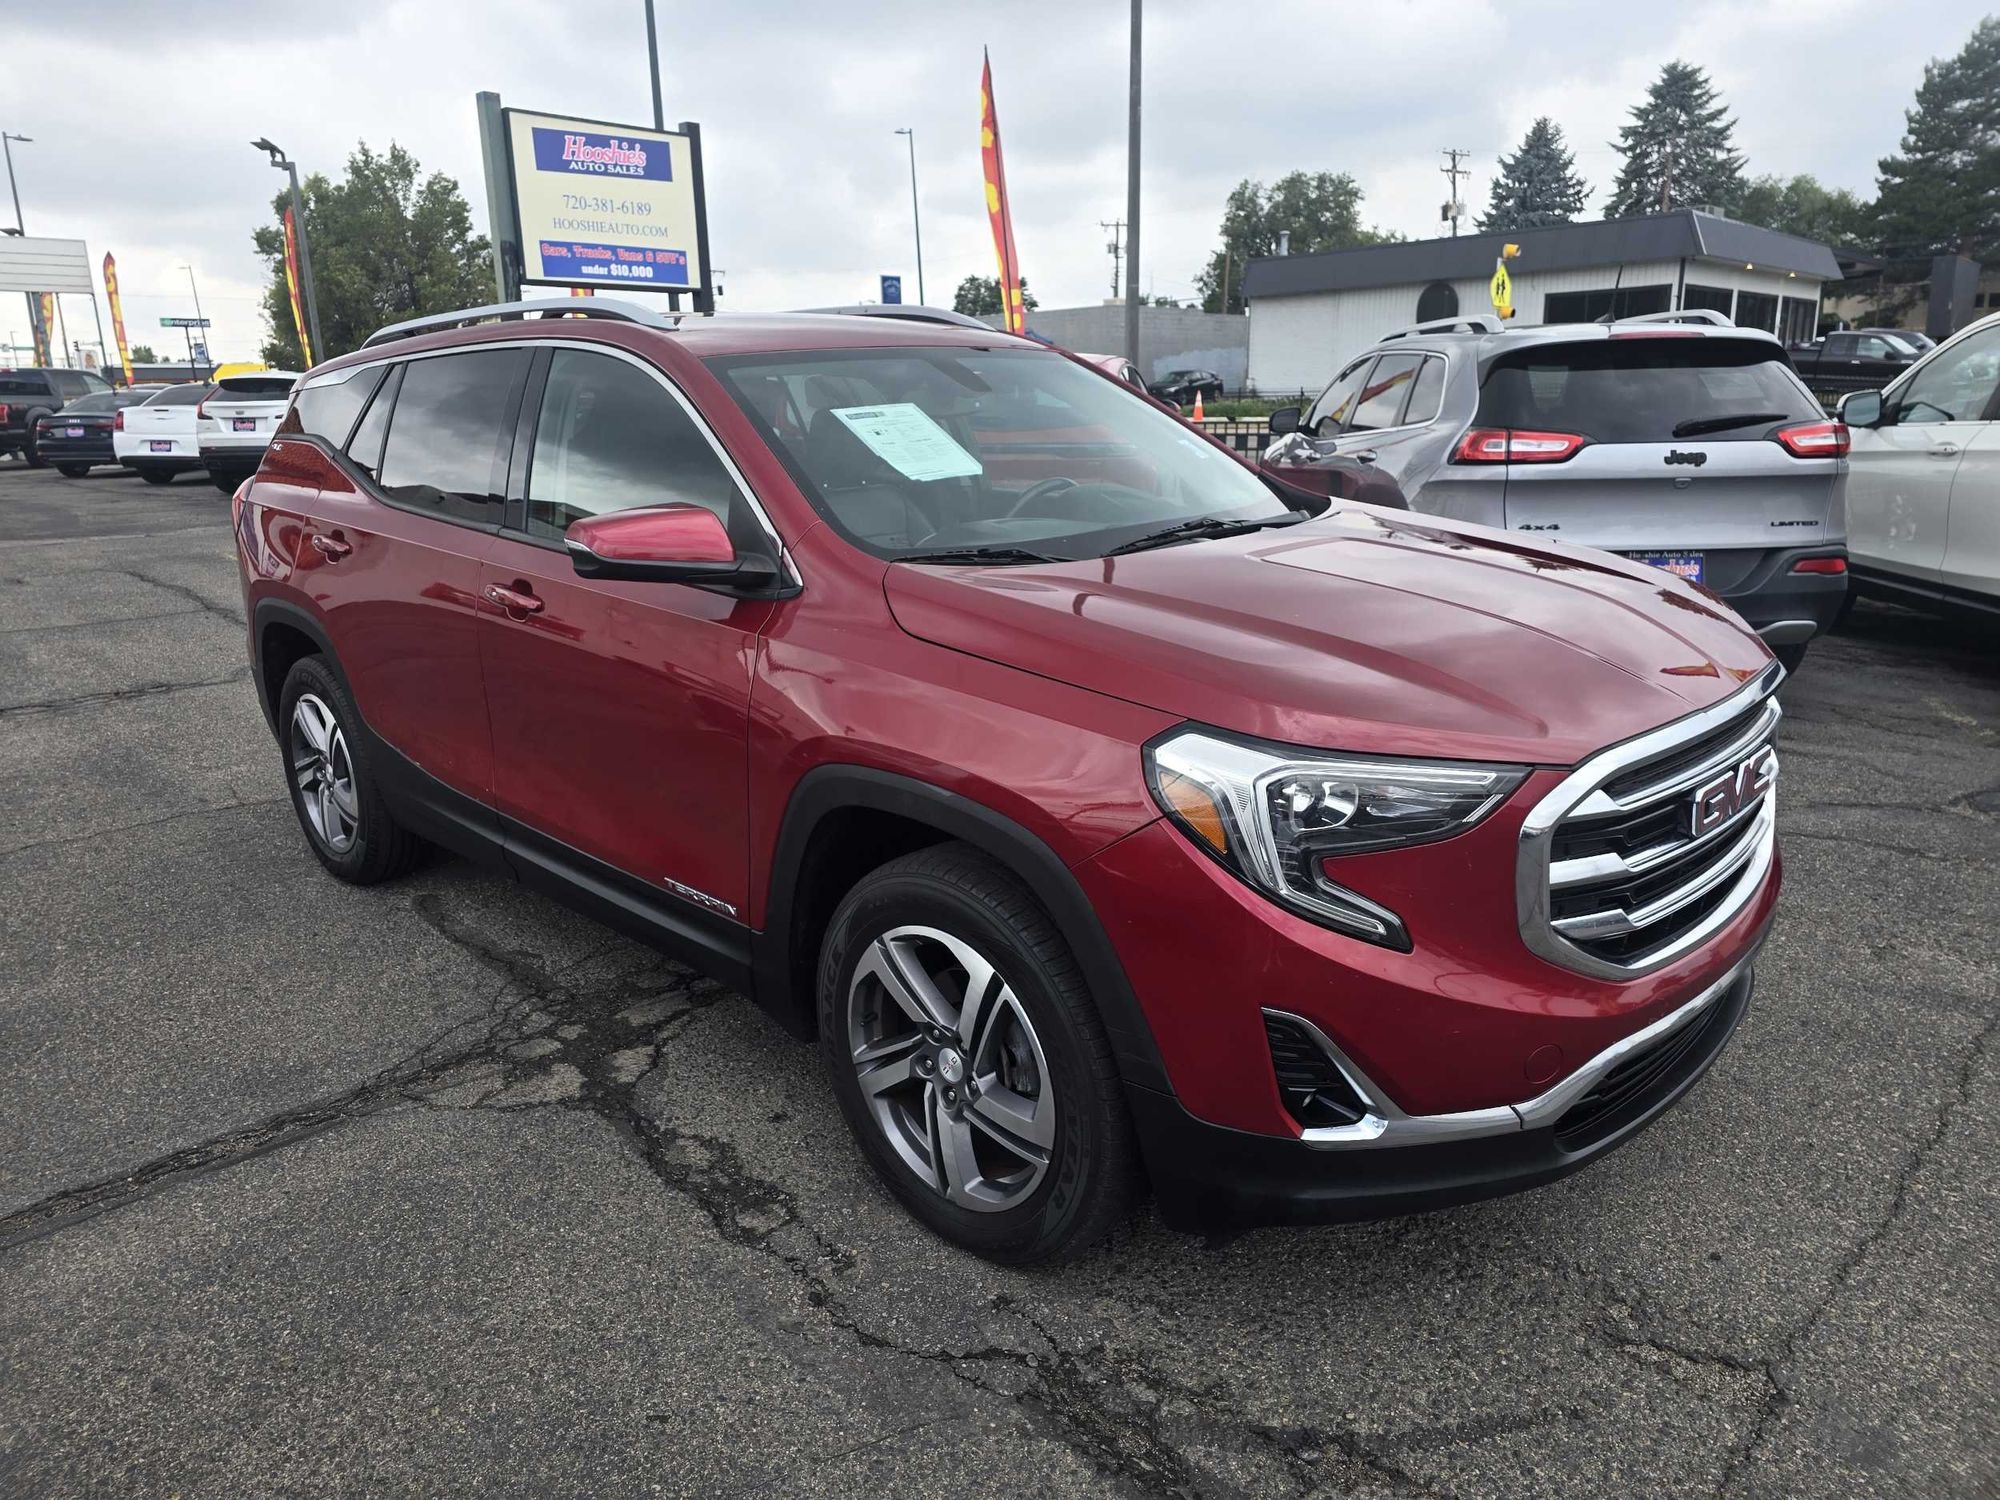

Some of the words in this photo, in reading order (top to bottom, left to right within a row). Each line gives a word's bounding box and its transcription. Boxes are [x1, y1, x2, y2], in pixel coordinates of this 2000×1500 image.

[562, 135, 646, 167] Hooshie's
[569, 161, 605, 172] AUTO
[607, 164, 644, 175] SALES
[562, 194, 652, 216] 720-381-6189
[553, 217, 669, 238] HOOSHIEAUTO.COM
[581, 265, 608, 275] under
[610, 264, 653, 278] $10,000
[1664, 450, 1708, 467] Jeep
[1662, 551, 1681, 559] Auto
[1692, 744, 1776, 837] GMC
[664, 877, 737, 916] TERRAIN
